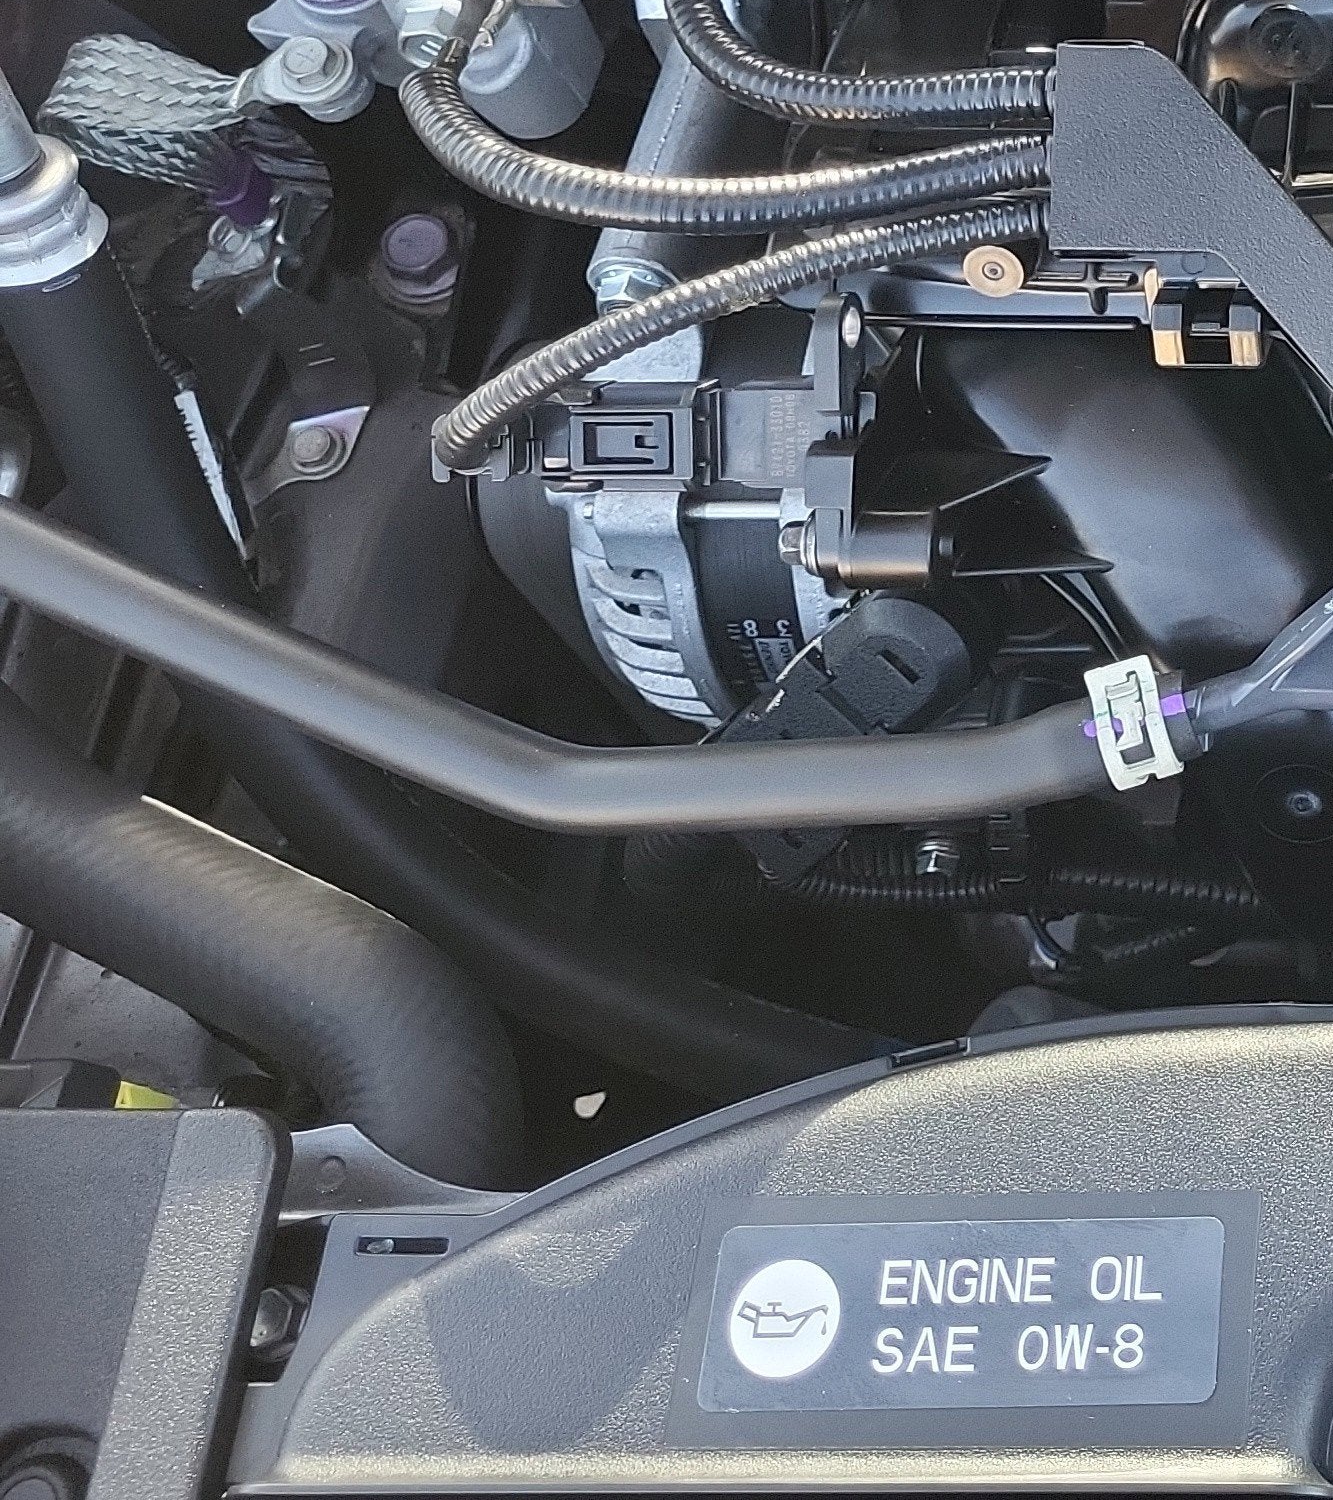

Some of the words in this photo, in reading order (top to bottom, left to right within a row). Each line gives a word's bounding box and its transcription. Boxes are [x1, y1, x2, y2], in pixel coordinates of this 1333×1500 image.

[878, 1256, 1056, 1306] ENGINE
[1089, 1255, 1163, 1301] OIL
[871, 1325, 979, 1374] SAE
